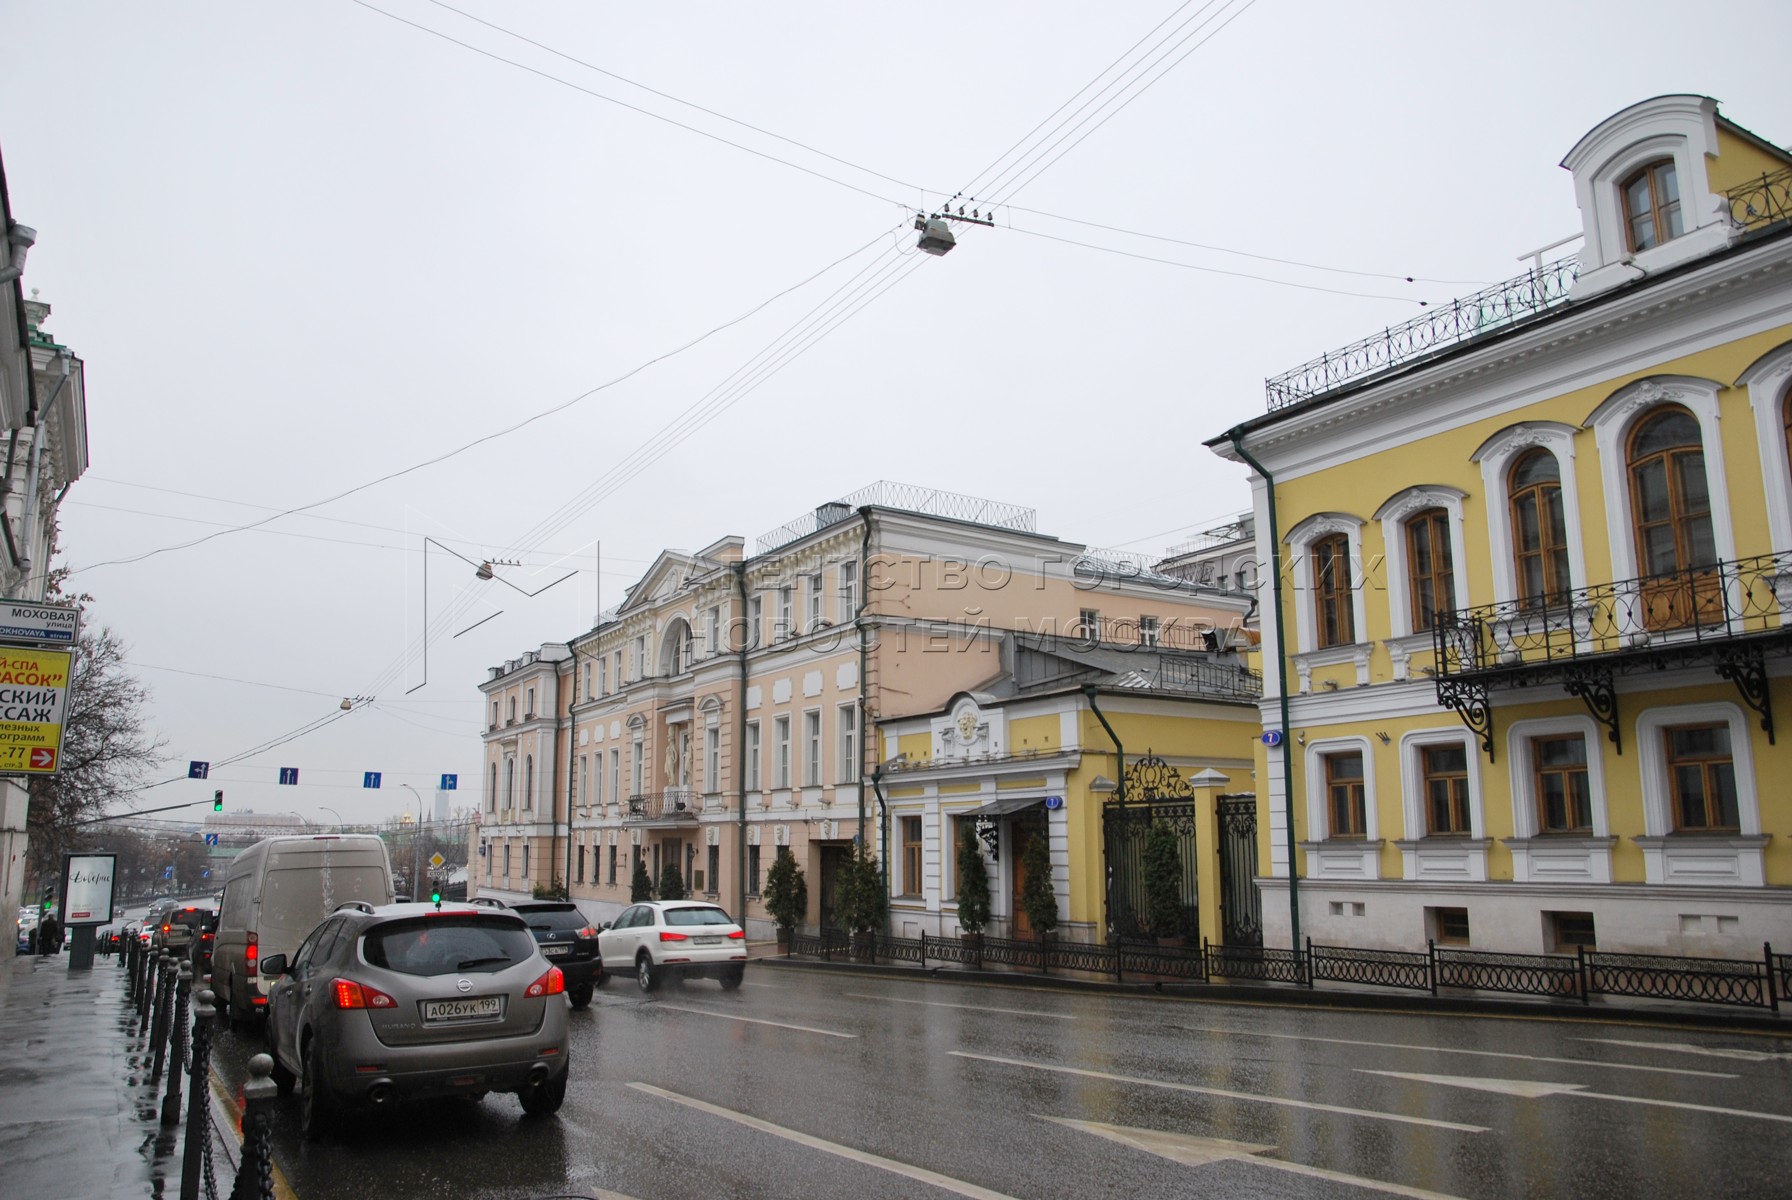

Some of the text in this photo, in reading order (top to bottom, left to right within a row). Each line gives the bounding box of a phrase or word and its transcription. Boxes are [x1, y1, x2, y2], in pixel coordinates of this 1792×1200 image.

[11, 608, 75, 622] МОХОВАЯ
[46, 621, 73, 629] улица
[0, 688, 57, 706] СКИЙ
[1268, 733, 1273, 742] 7
[430, 1002, 477, 1017] А026УК
[479, 999, 497, 1009] 199
